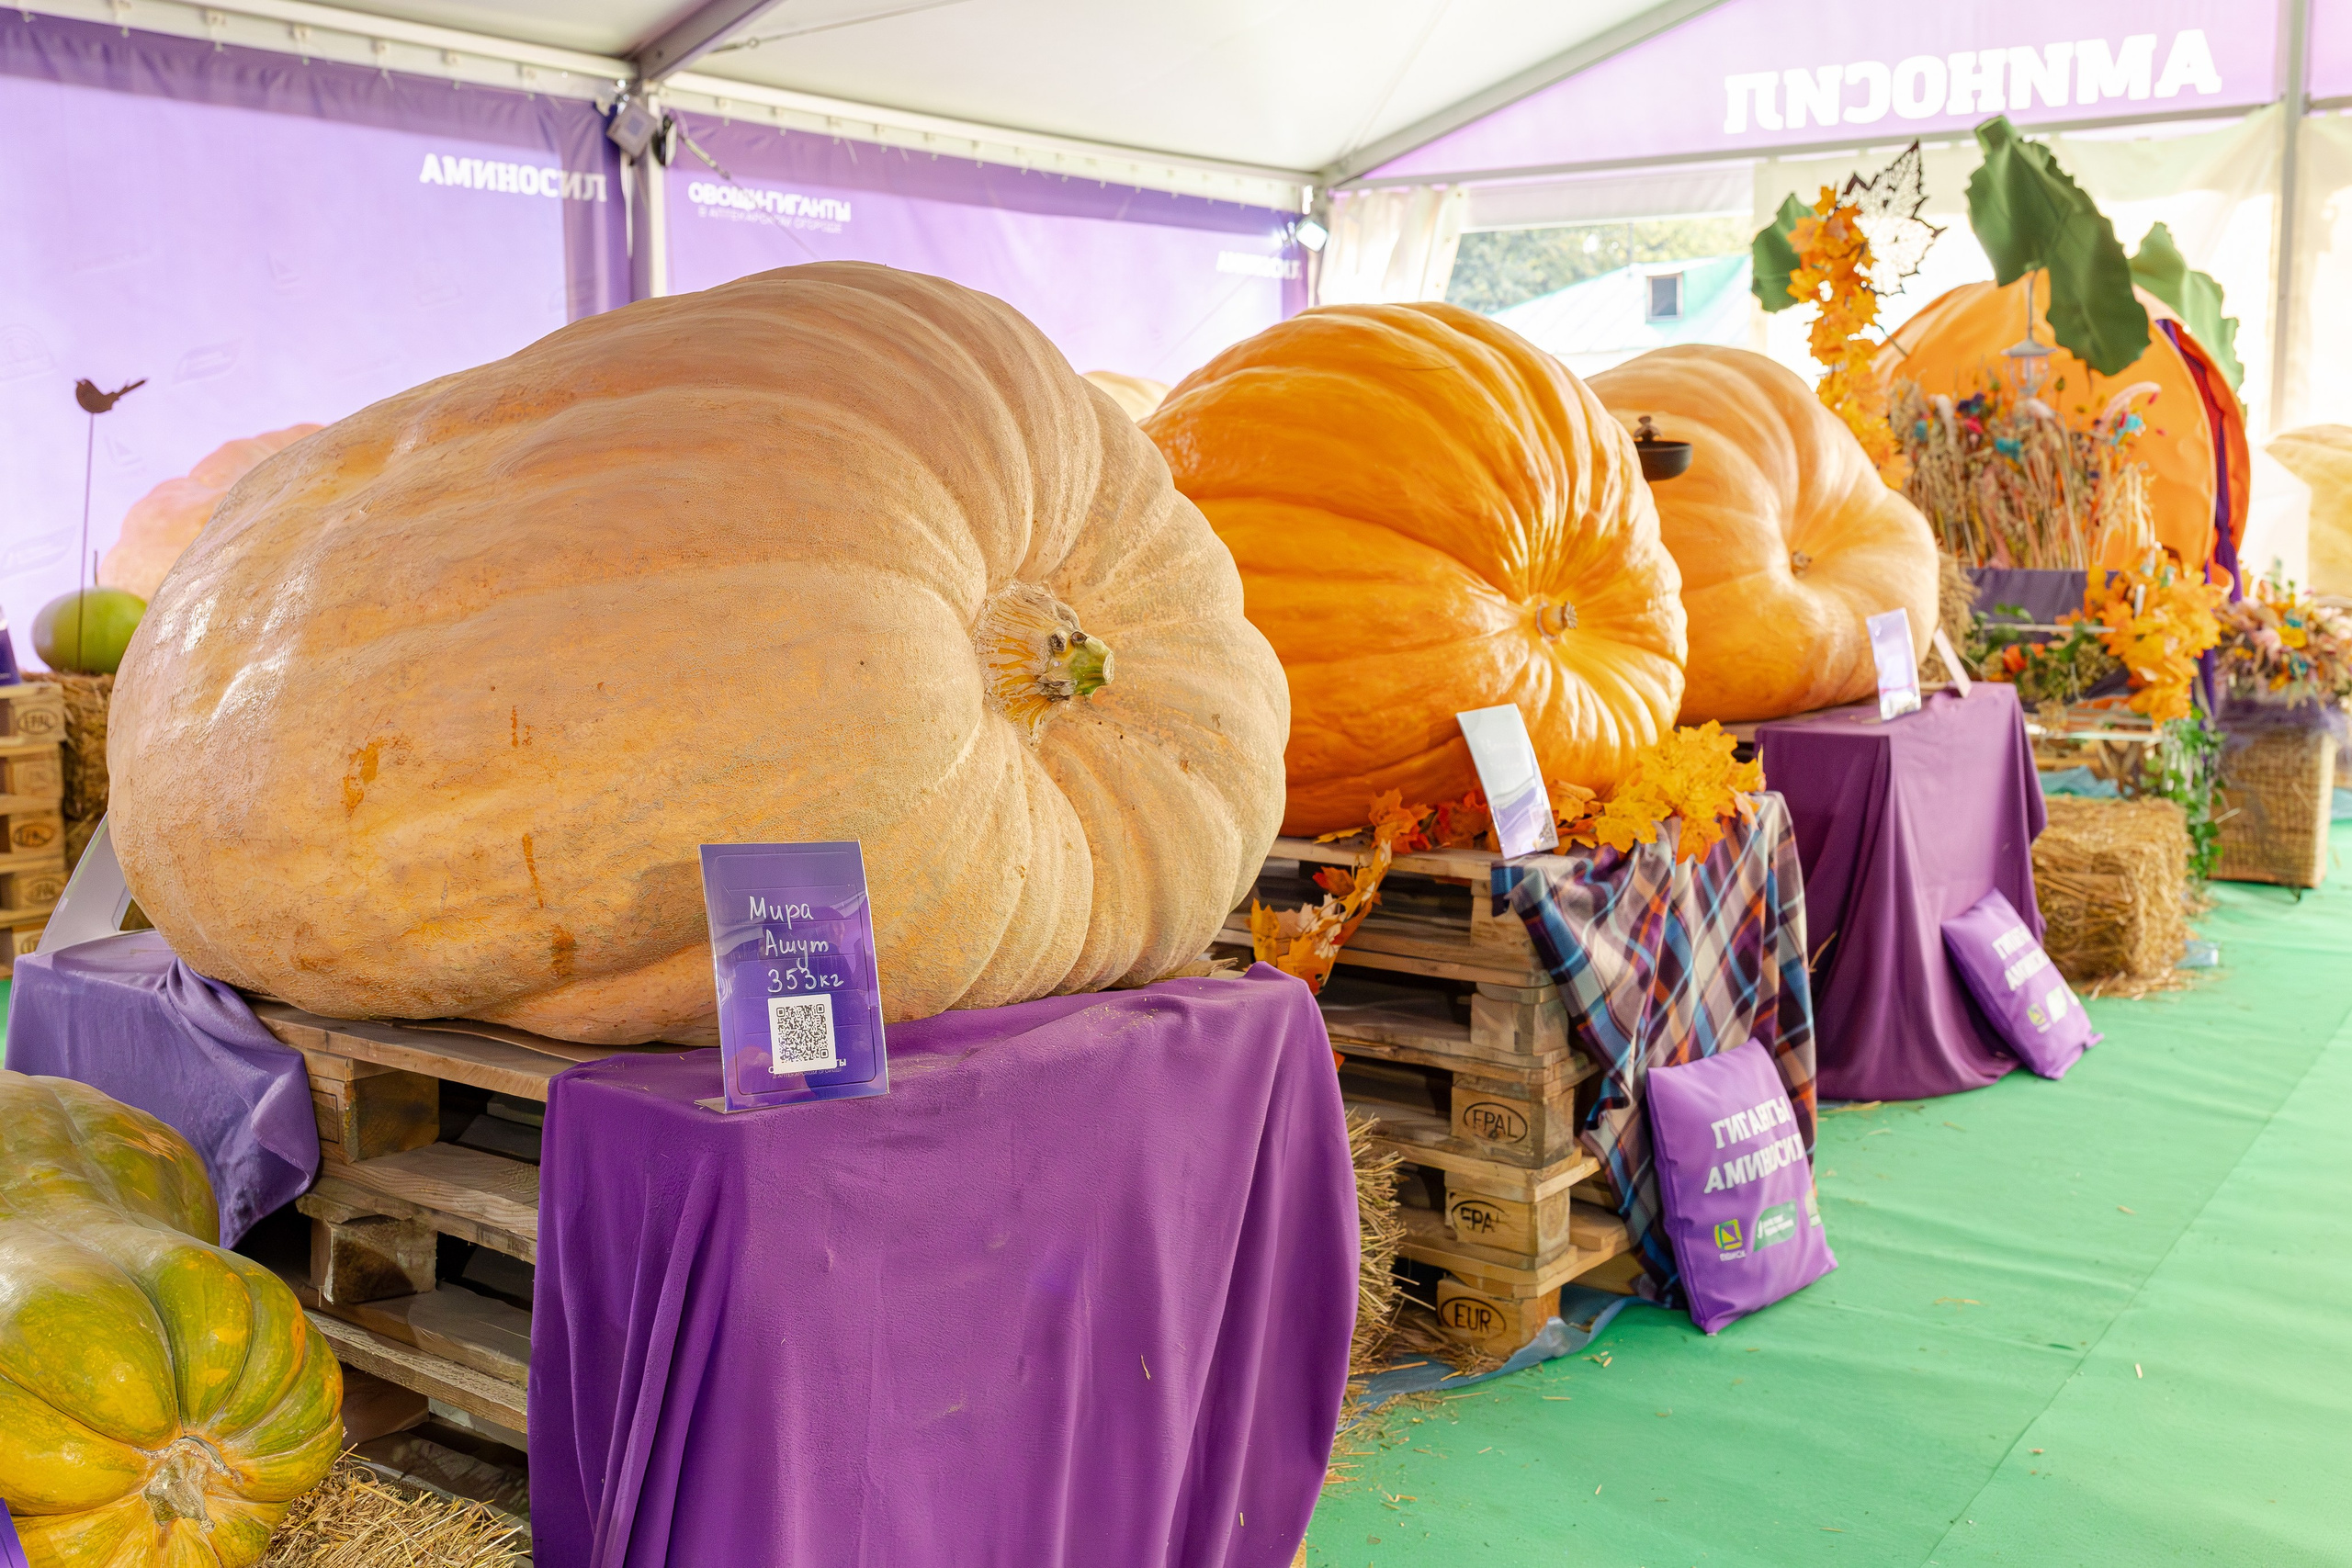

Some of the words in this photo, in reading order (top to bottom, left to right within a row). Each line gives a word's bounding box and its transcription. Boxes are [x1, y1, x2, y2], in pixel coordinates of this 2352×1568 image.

[419, 152, 607, 203] АМИНОСИЛ
[749, 896, 814, 930] Мира
[764, 929, 830, 970] Ашут
[1710, 1095, 1792, 1149] ГИГАНТЫ
[1453, 1302, 1490, 1334] EUR
